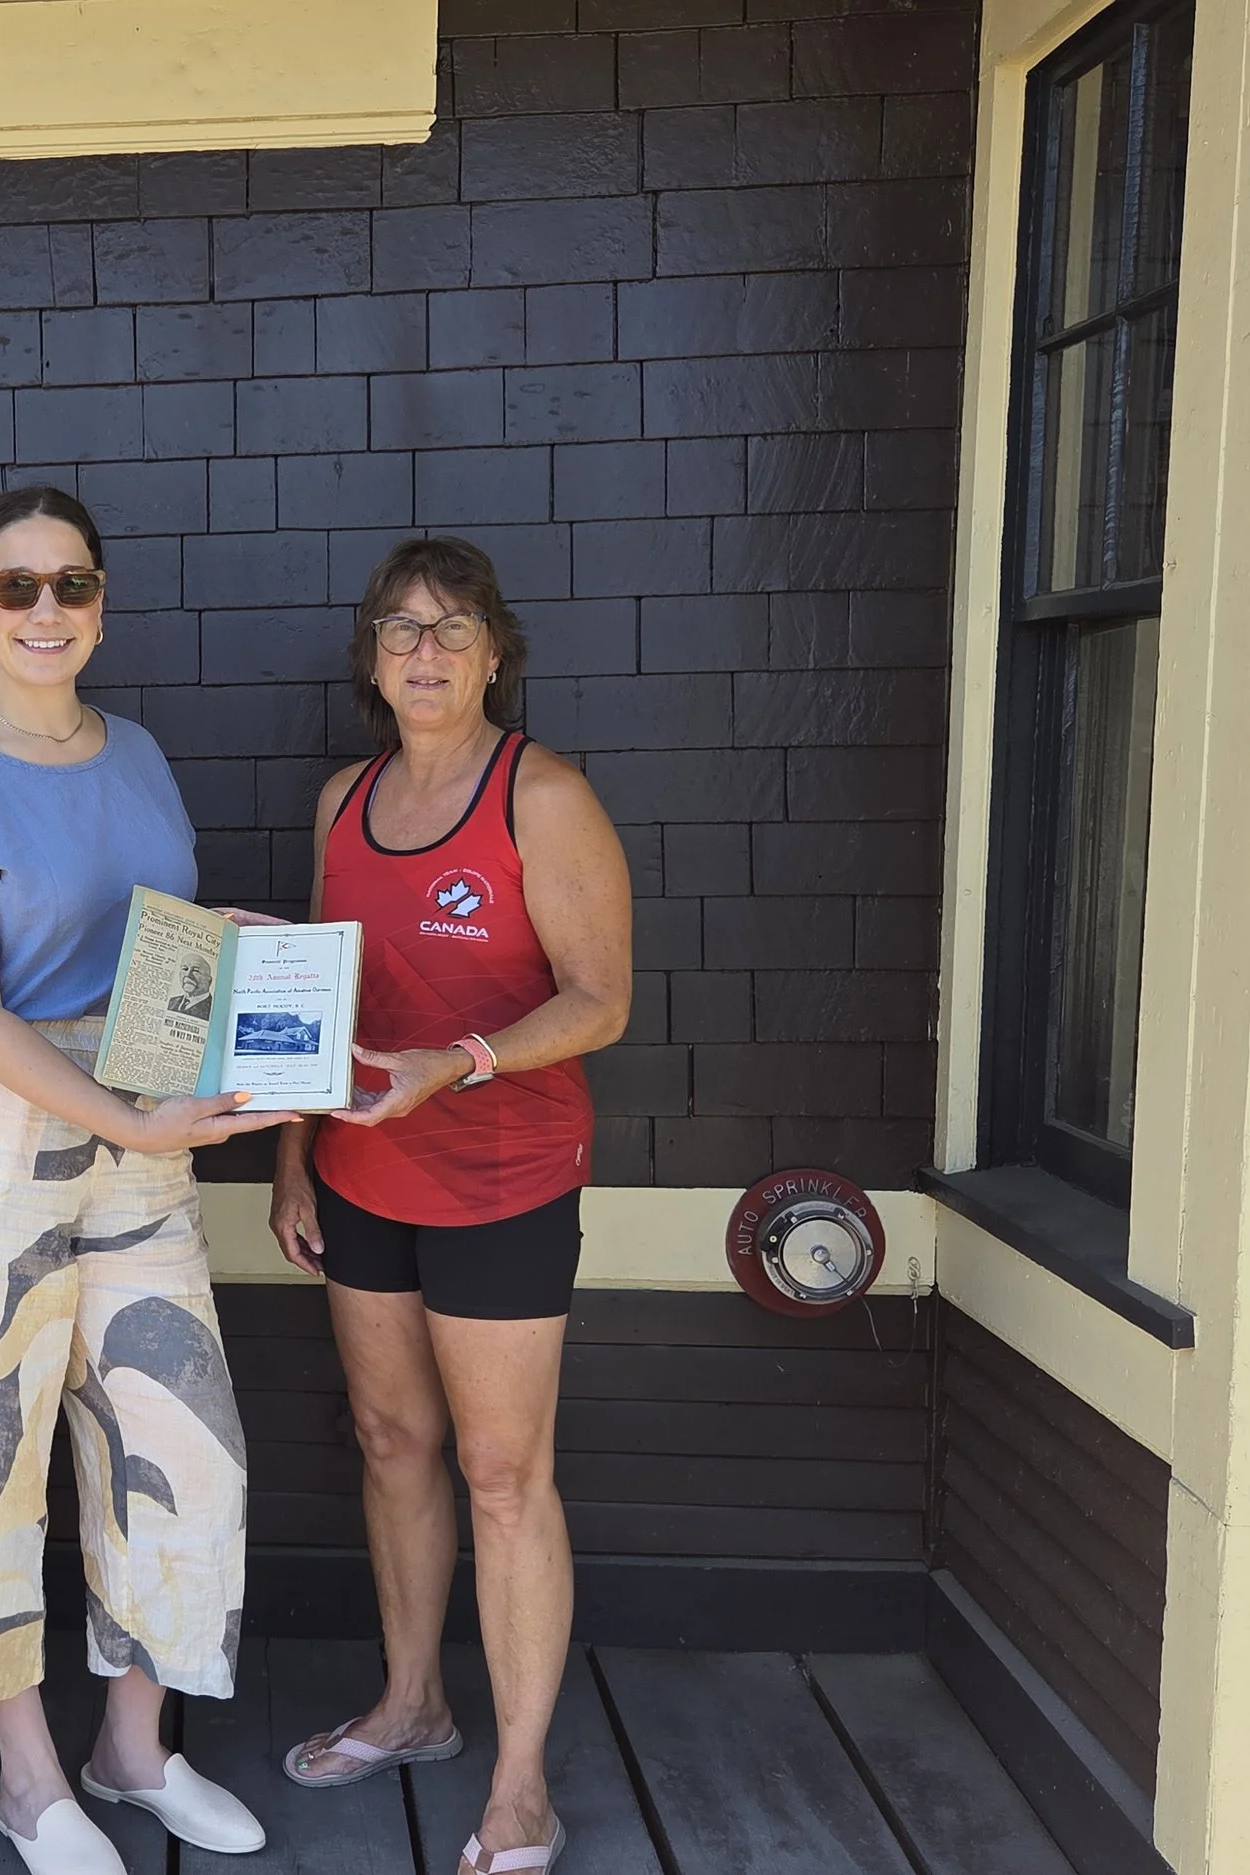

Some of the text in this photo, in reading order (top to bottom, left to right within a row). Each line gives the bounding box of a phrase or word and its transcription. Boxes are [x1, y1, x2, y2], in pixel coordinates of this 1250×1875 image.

[138, 923, 163, 937] Pioneer
[177, 936, 193, 947] Next
[141, 910, 179, 931] Prominent
[182, 925, 204, 940] Royal
[205, 934, 221, 948] City
[419, 920, 489, 939] CANADA
[738, 1178, 867, 1256] AUTO SPRINKLER
